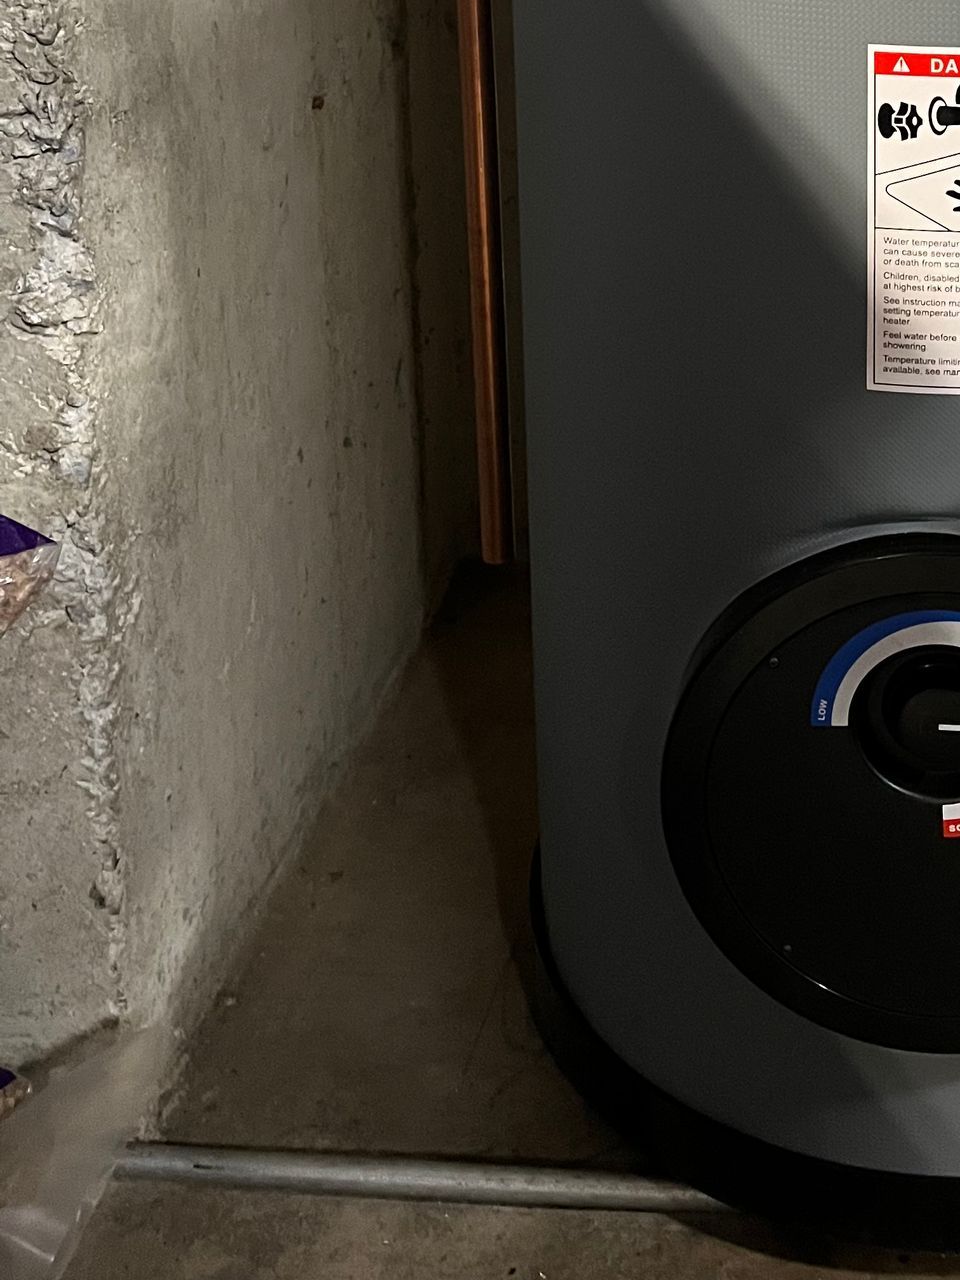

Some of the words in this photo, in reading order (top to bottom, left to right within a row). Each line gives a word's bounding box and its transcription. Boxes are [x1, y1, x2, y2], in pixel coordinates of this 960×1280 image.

[884, 236, 909, 245] Water
[902, 249, 928, 257] cause
[931, 250, 960, 258] severe
[894, 259, 920, 267] death
[922, 259, 942, 267] from
[924, 275, 960, 283] disabled
[894, 282, 925, 293] highest
[927, 284, 942, 292] risk
[944, 285, 953, 293] of
[884, 296, 900, 305] See
[883, 308, 911, 317] setting
[883, 331, 902, 339] Feel
[930, 333, 957, 341] before
[883, 355, 936, 365] Temperature
[925, 368, 941, 376] see
[818, 699, 828, 720] LOW
